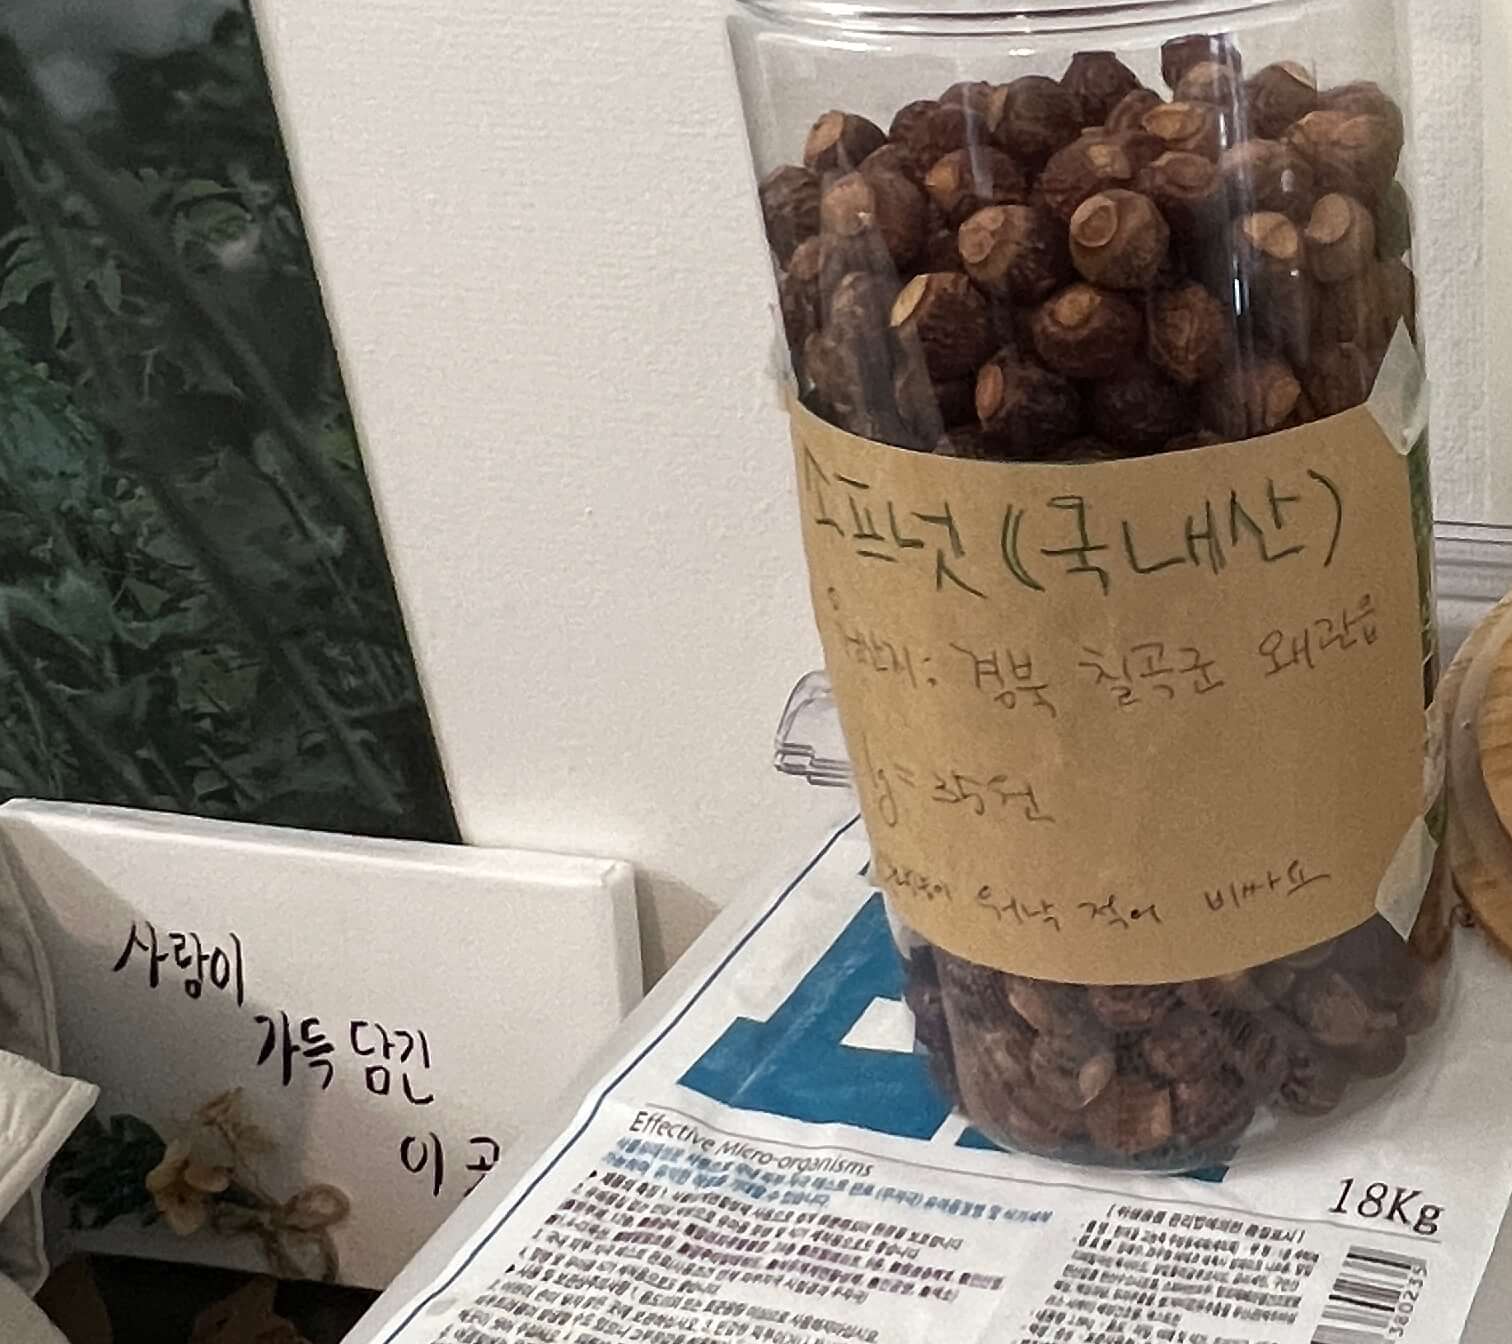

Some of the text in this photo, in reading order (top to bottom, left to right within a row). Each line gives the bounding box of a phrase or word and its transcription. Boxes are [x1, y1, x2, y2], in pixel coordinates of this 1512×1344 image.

[1078, 642, 1225, 706] 칠곡군
[1258, 593, 1376, 678] 왜관읍
[1204, 859, 1331, 911] 비싸요
[112, 921, 244, 1007] 사랑이
[254, 1010, 434, 1105] 가득 담긴
[629, 1111, 717, 1150] Effective
[714, 1137, 874, 1178] Micro-organisms
[1328, 1178, 1445, 1235] 18Kg
